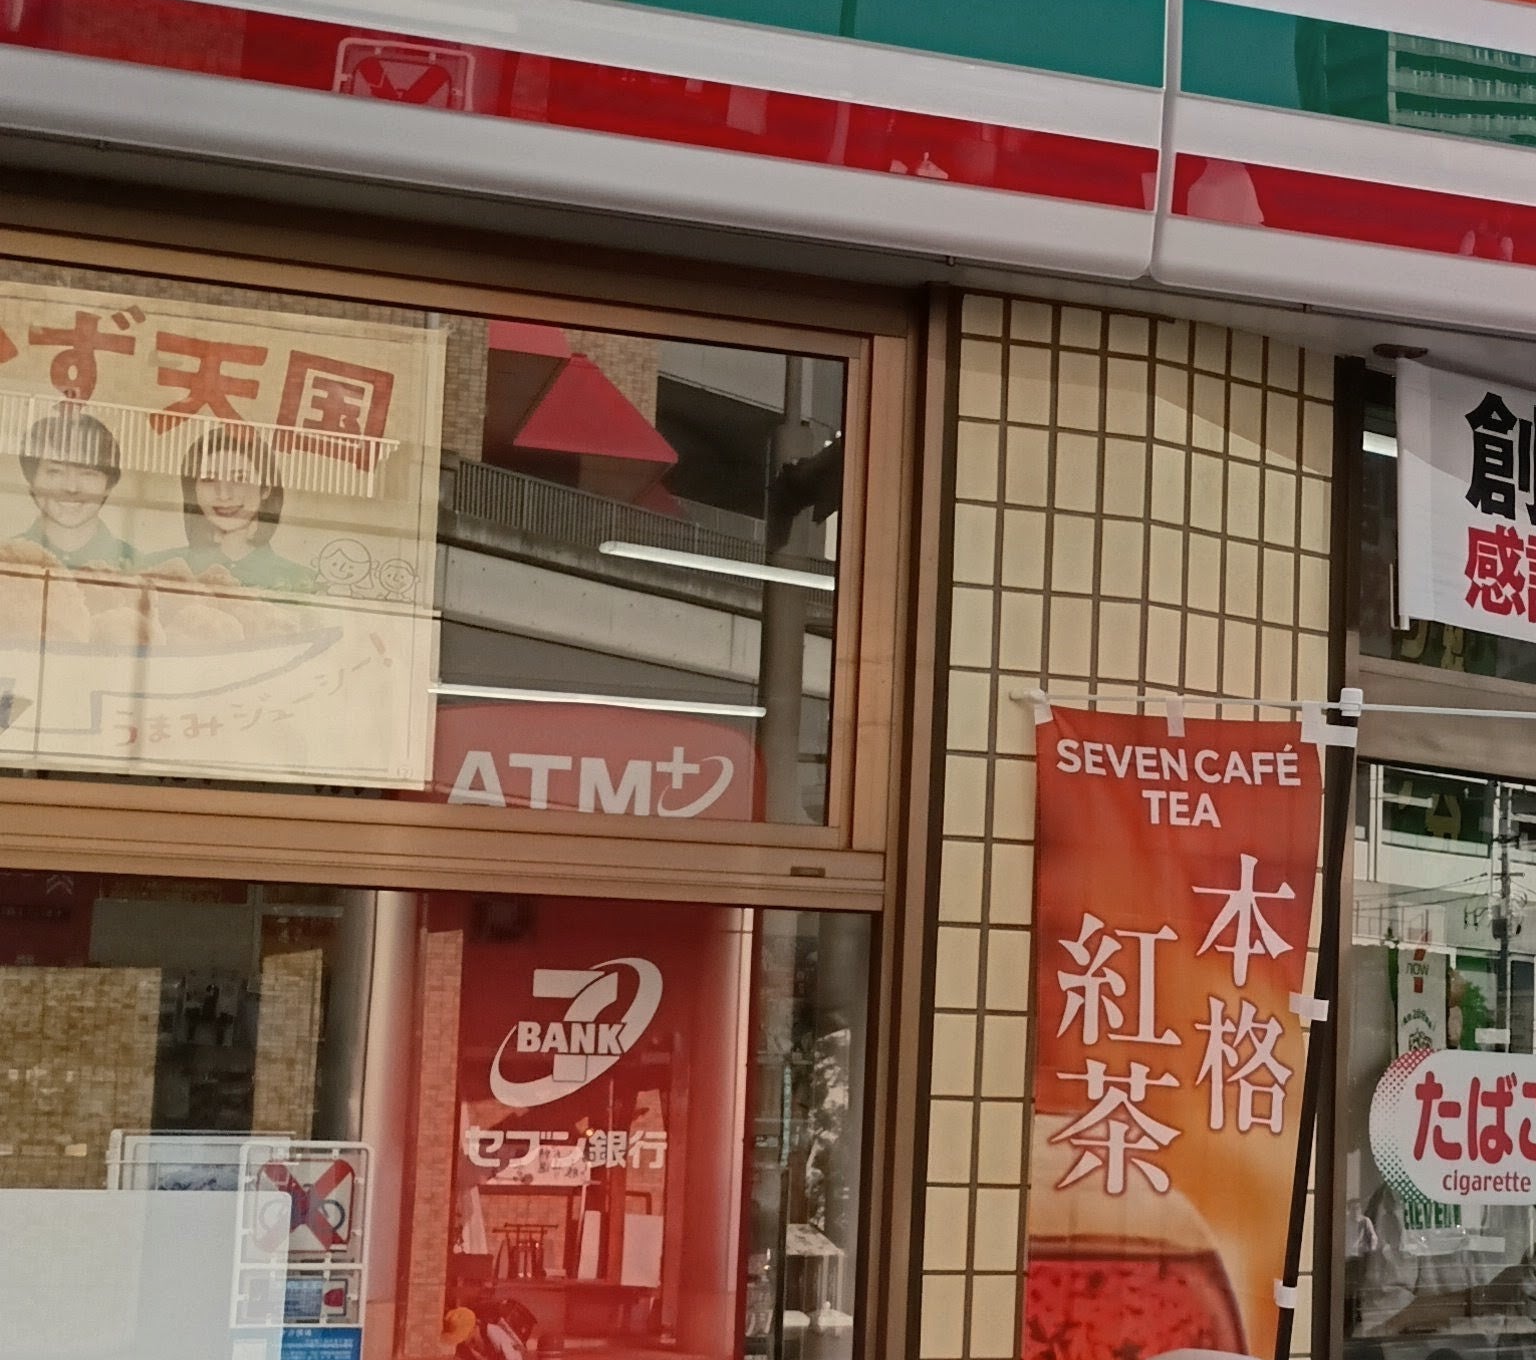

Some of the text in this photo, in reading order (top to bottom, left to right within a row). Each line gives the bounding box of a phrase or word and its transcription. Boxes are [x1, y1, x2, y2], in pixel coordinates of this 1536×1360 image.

[0, 305, 395, 471] ず天国
[1056, 739, 1301, 786] SEVEN CAFÉ
[1141, 790, 1222, 829] TEA
[1191, 853, 1296, 1135] 本格
[517, 1021, 627, 1055] BANK
[1051, 912, 1183, 1196] 紅茶
[465, 1126, 668, 1169] セブン銀行
[1442, 1171, 1531, 1196] cigarette
